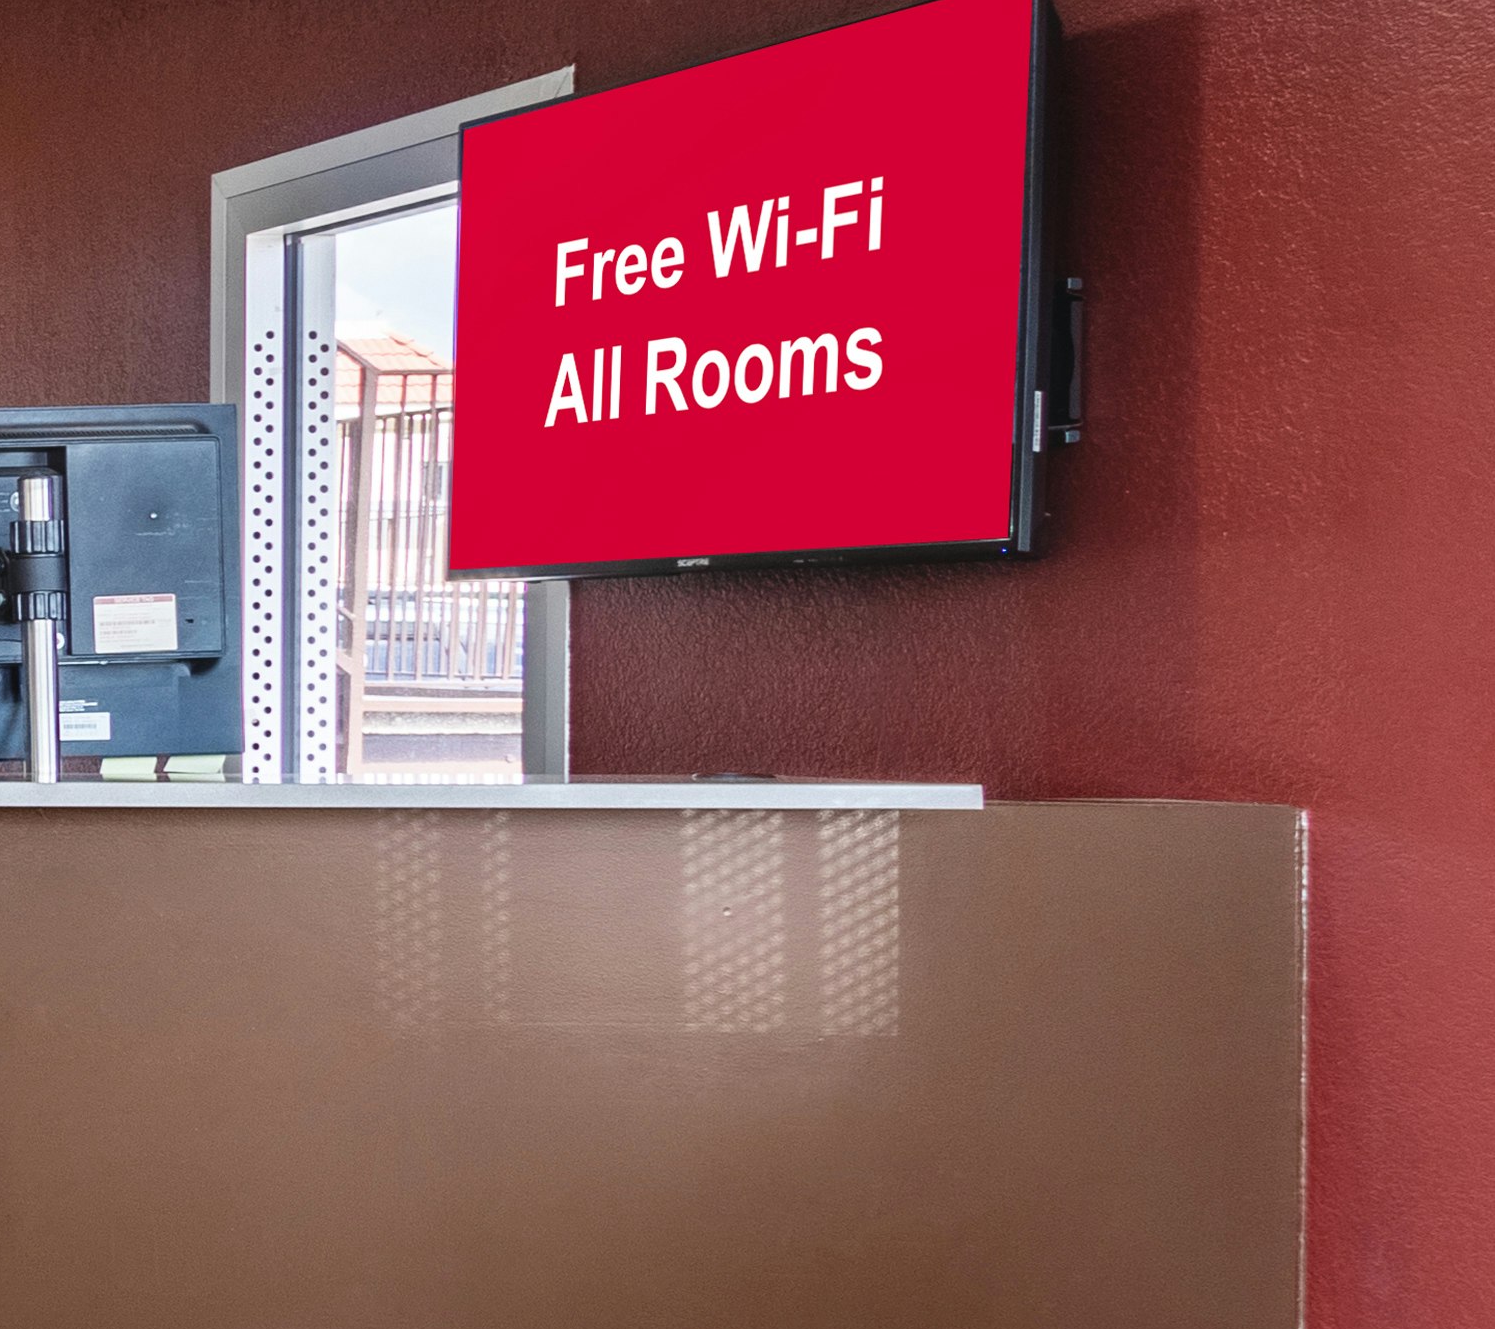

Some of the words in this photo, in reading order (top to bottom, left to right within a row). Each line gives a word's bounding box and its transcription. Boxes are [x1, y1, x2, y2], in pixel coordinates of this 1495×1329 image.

[555, 236, 685, 308] Free
[706, 176, 884, 279] Wi-Fi
[543, 345, 622, 428] All
[645, 326, 884, 416] Rooms
